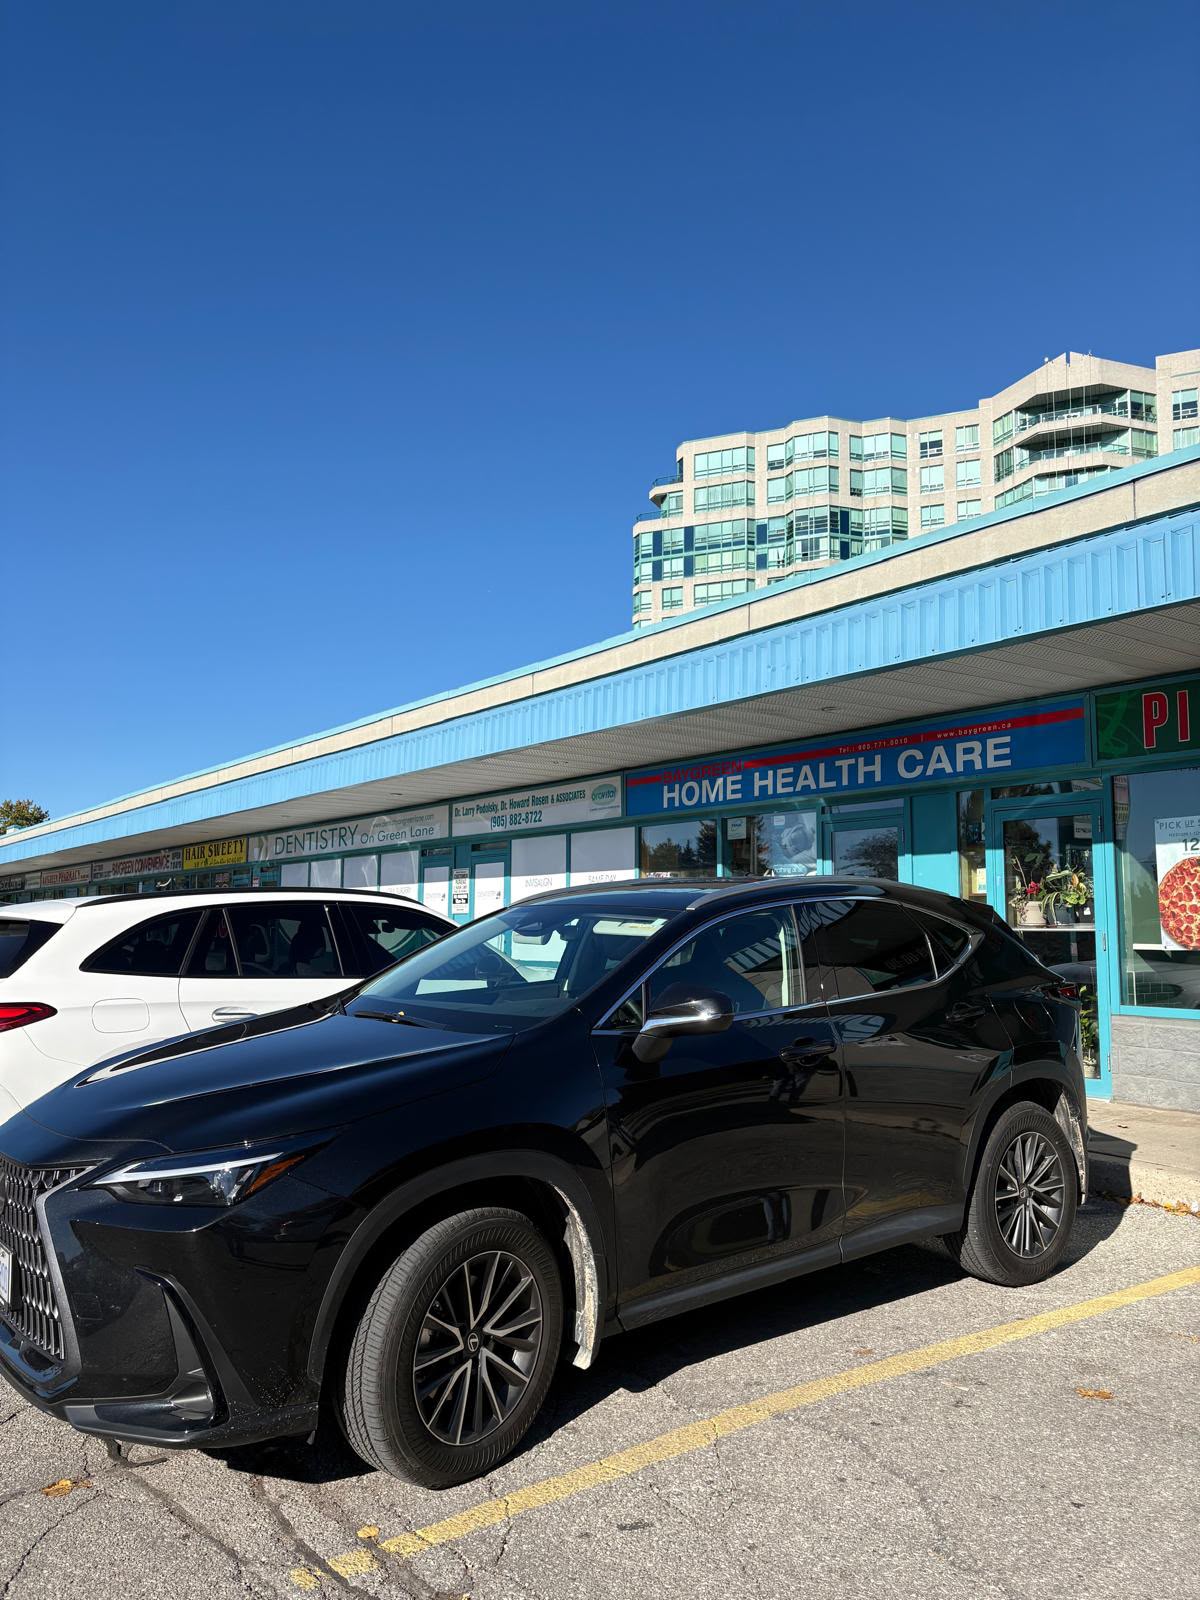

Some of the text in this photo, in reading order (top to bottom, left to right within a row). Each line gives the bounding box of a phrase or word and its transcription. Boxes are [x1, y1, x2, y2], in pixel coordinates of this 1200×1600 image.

[937, 722, 1012, 739] www.baygreen.ca
[1142, 690, 1190, 749] PI
[663, 759, 743, 784] BAYGREEN
[663, 736, 1012, 808] HOME HEALTH CARE
[462, 805, 475, 817] Larry
[500, 800, 508, 811] Dr.
[509, 797, 530, 810] Howard
[531, 795, 549, 806] Rosen
[556, 789, 586, 804] ASSOCIATES
[490, 810, 543, 830] (905) 882-8722
[1159, 821, 1182, 830] PICK
[185, 839, 245, 861] HAIR SWEETY
[274, 824, 359, 855] DENTISTRY
[377, 830, 407, 842] Green
[410, 825, 434, 839] Lane
